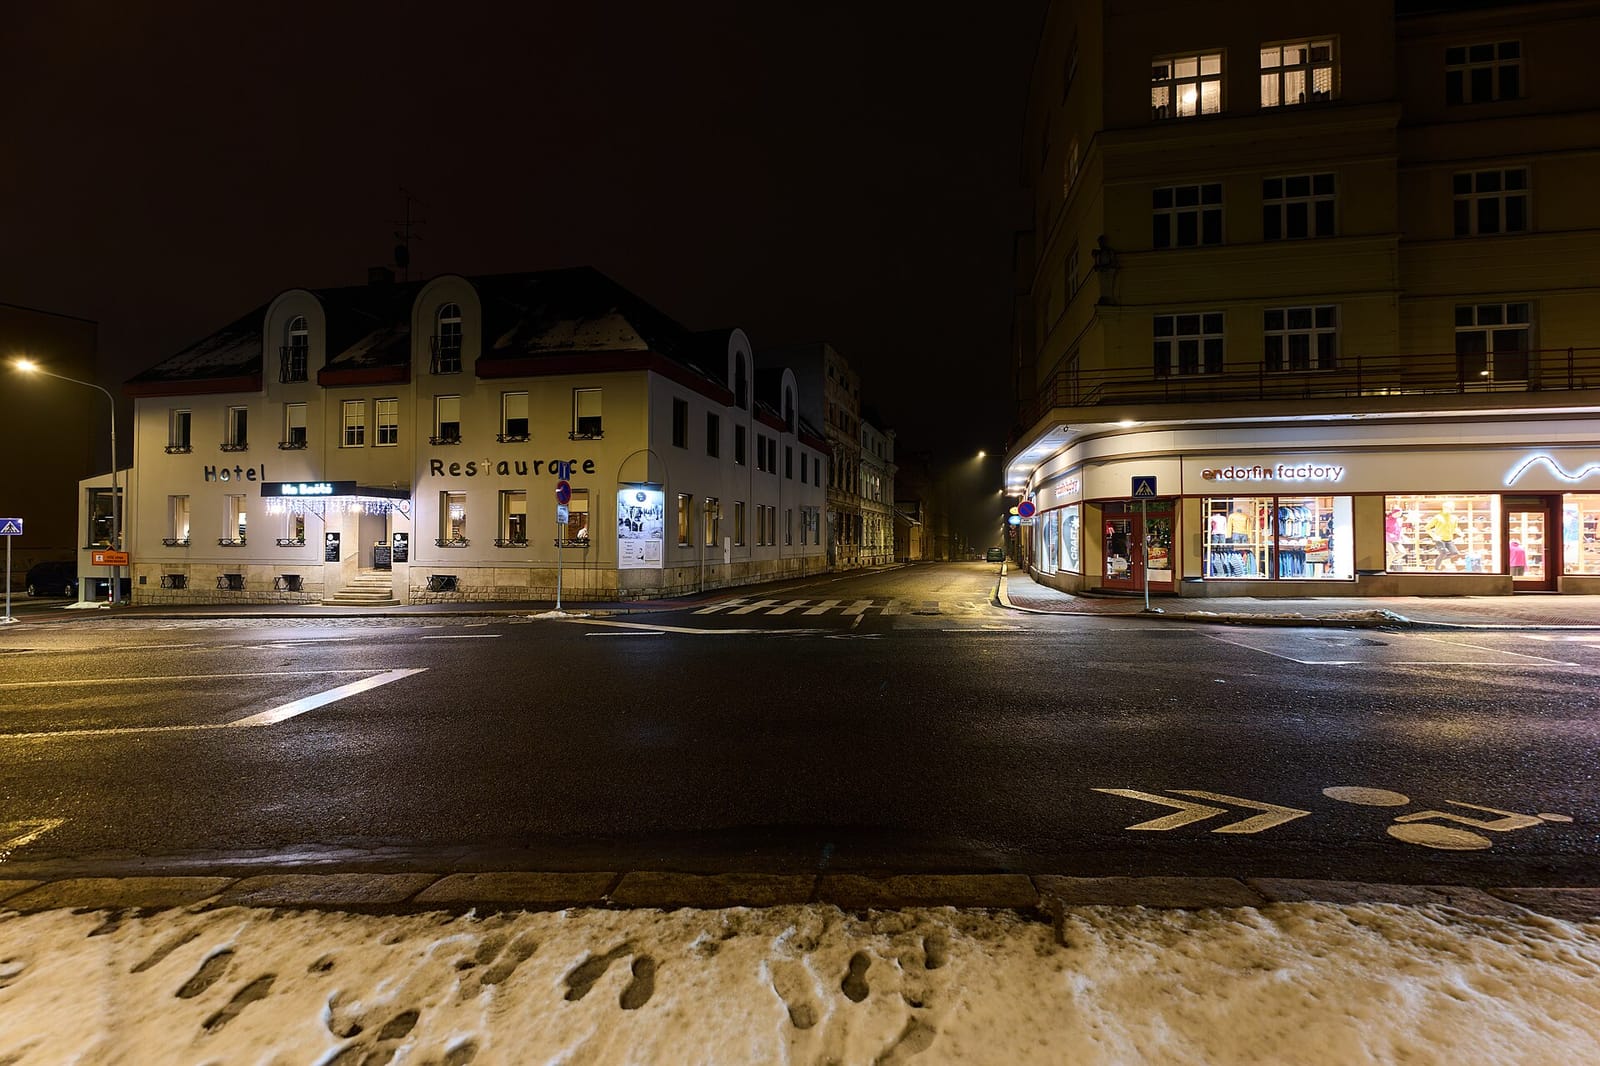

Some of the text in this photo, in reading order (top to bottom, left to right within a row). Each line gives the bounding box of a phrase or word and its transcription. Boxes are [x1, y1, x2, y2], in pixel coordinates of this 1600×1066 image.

[204, 463, 265, 482] Hotel
[430, 458, 596, 477] Restaurace
[1202, 464, 1343, 481] endorfin factory
[1070, 527, 1079, 561] CRAFT
